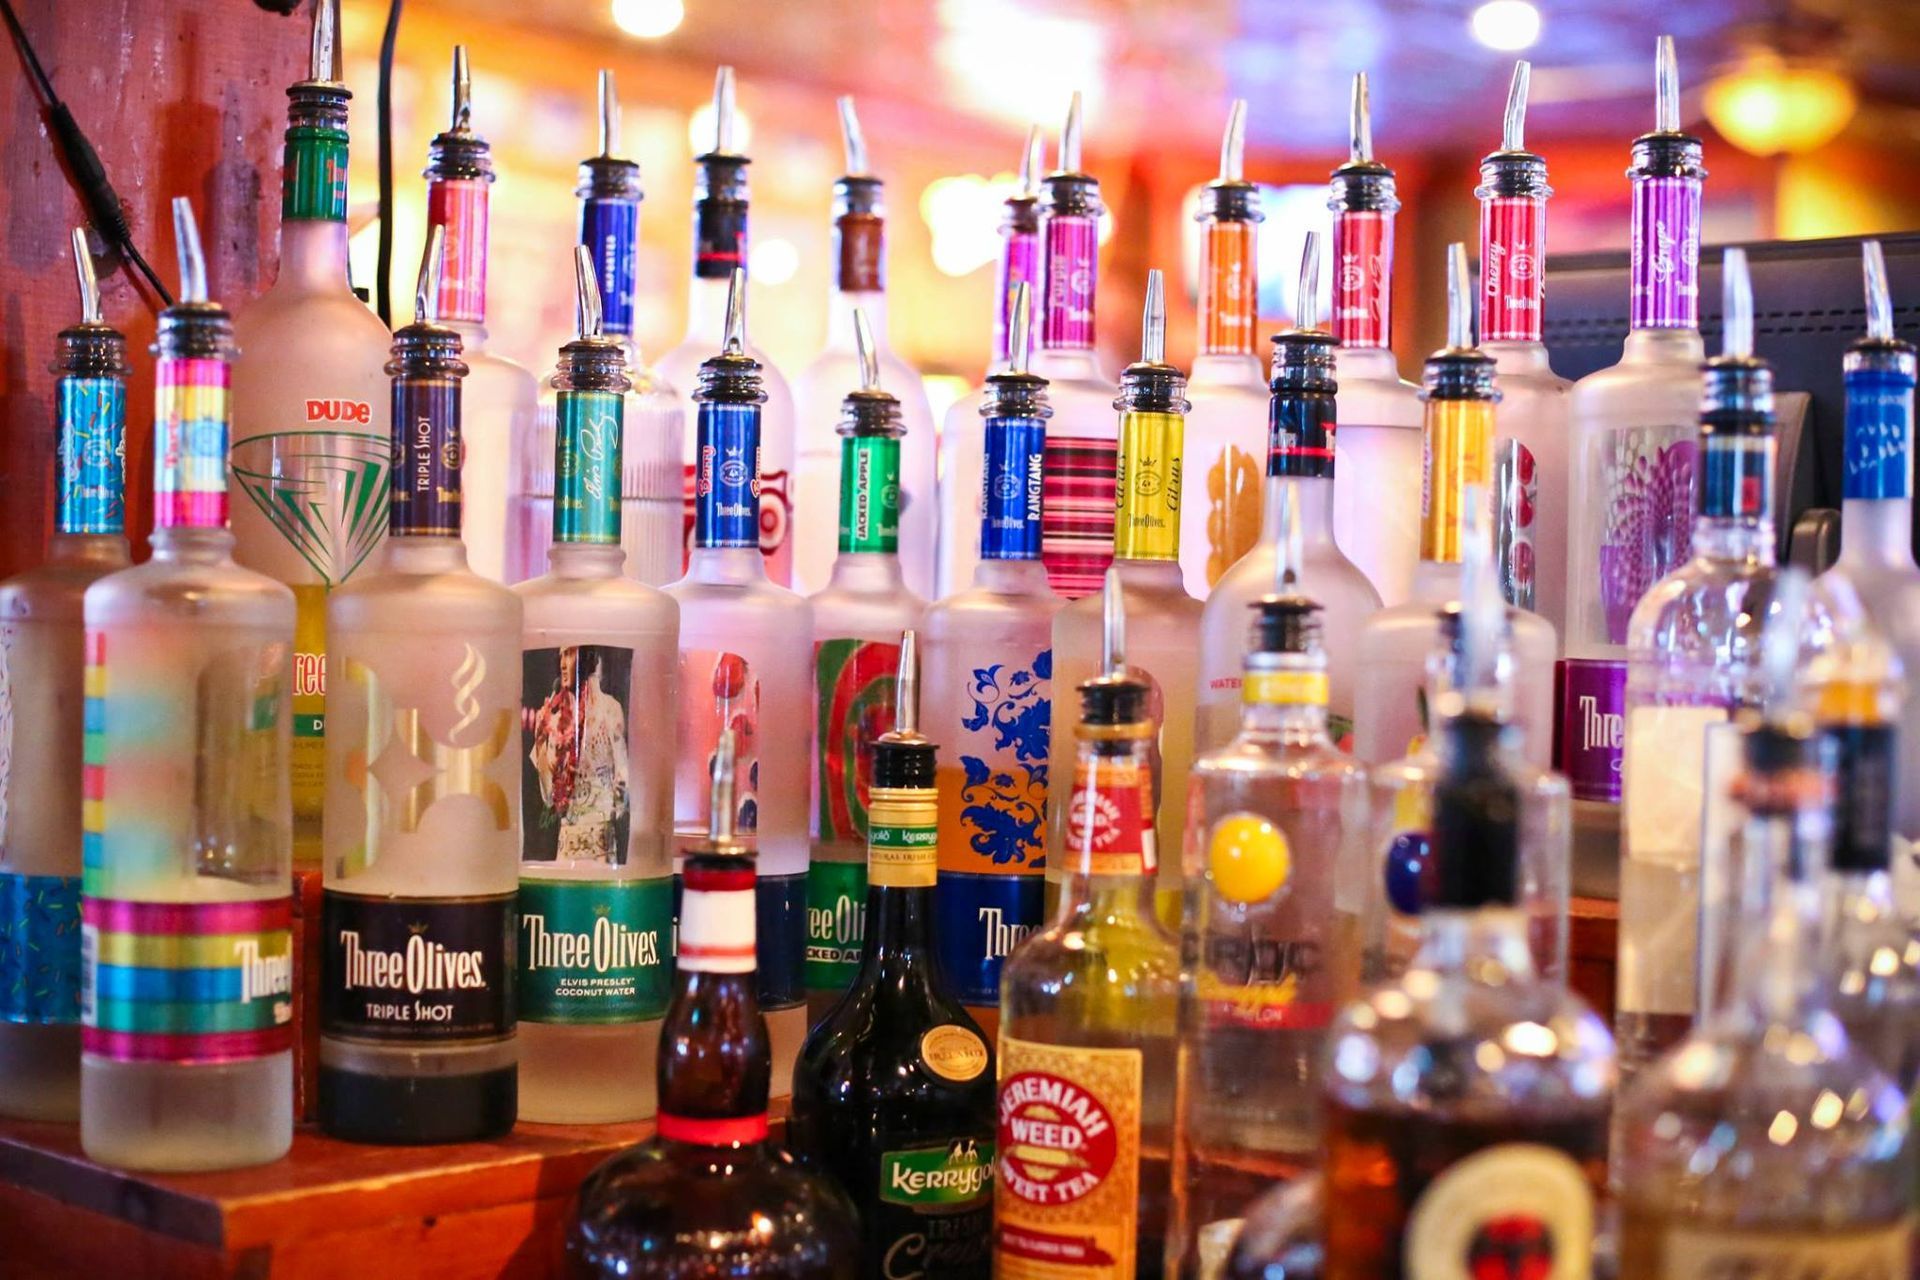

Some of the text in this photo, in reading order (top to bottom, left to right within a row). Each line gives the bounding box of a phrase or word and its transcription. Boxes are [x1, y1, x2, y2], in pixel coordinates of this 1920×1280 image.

[413, 416, 431, 492] TRIPLE SHOT
[698, 445, 716, 498] Berry
[858, 450, 870, 539] JACKED APPLE
[1026, 452, 1043, 522] RANGTANG
[1579, 695, 1624, 751] Thre
[340, 929, 403, 990] Three
[522, 913, 591, 971] Three
[555, 987, 636, 997] COCONUT WATER
[560, 978, 588, 987] ELVIS
[366, 1000, 454, 1021] TRIPLE SHOT
[1010, 1116, 1083, 1150] WEED
[1053, 1170, 1101, 1202] TEA
